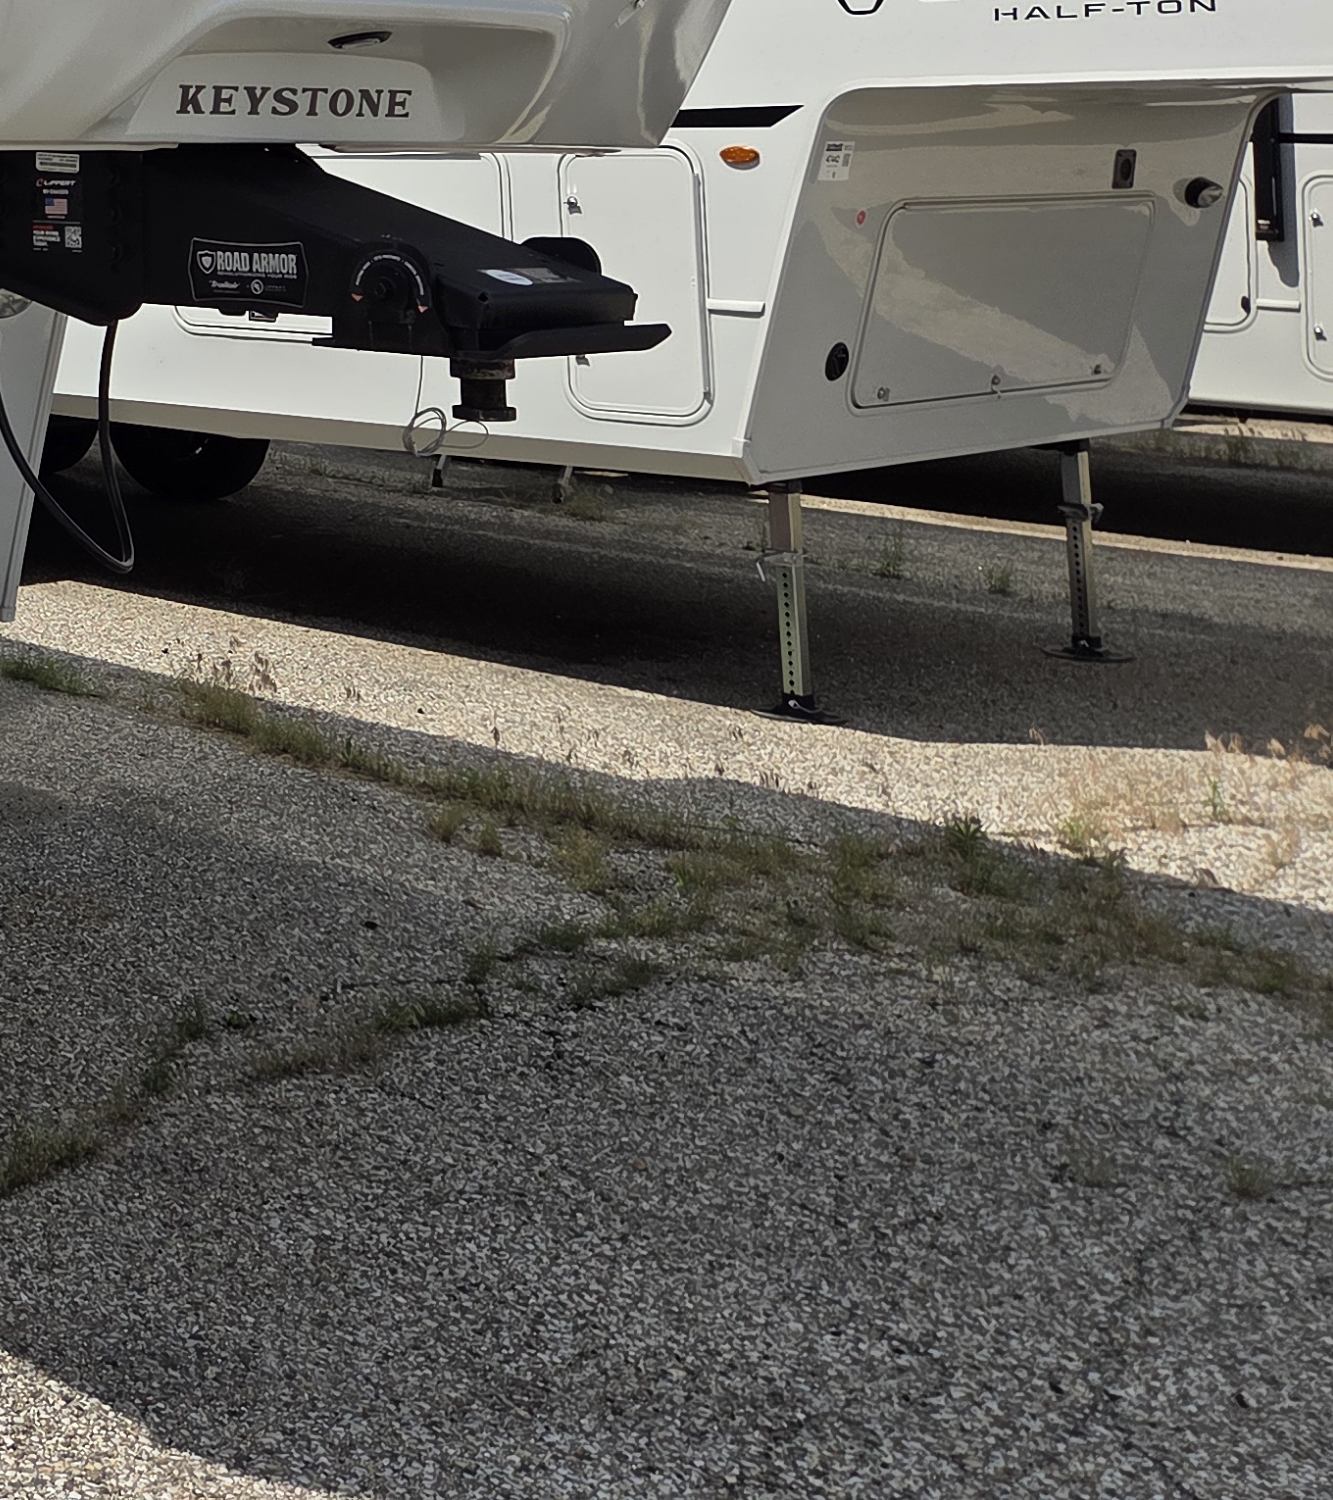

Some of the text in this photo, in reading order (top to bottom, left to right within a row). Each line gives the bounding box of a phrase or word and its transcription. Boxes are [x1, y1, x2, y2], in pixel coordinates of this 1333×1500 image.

[175, 83, 413, 118] KEYSTONE
[216, 250, 298, 275] ROAD ARMOR
